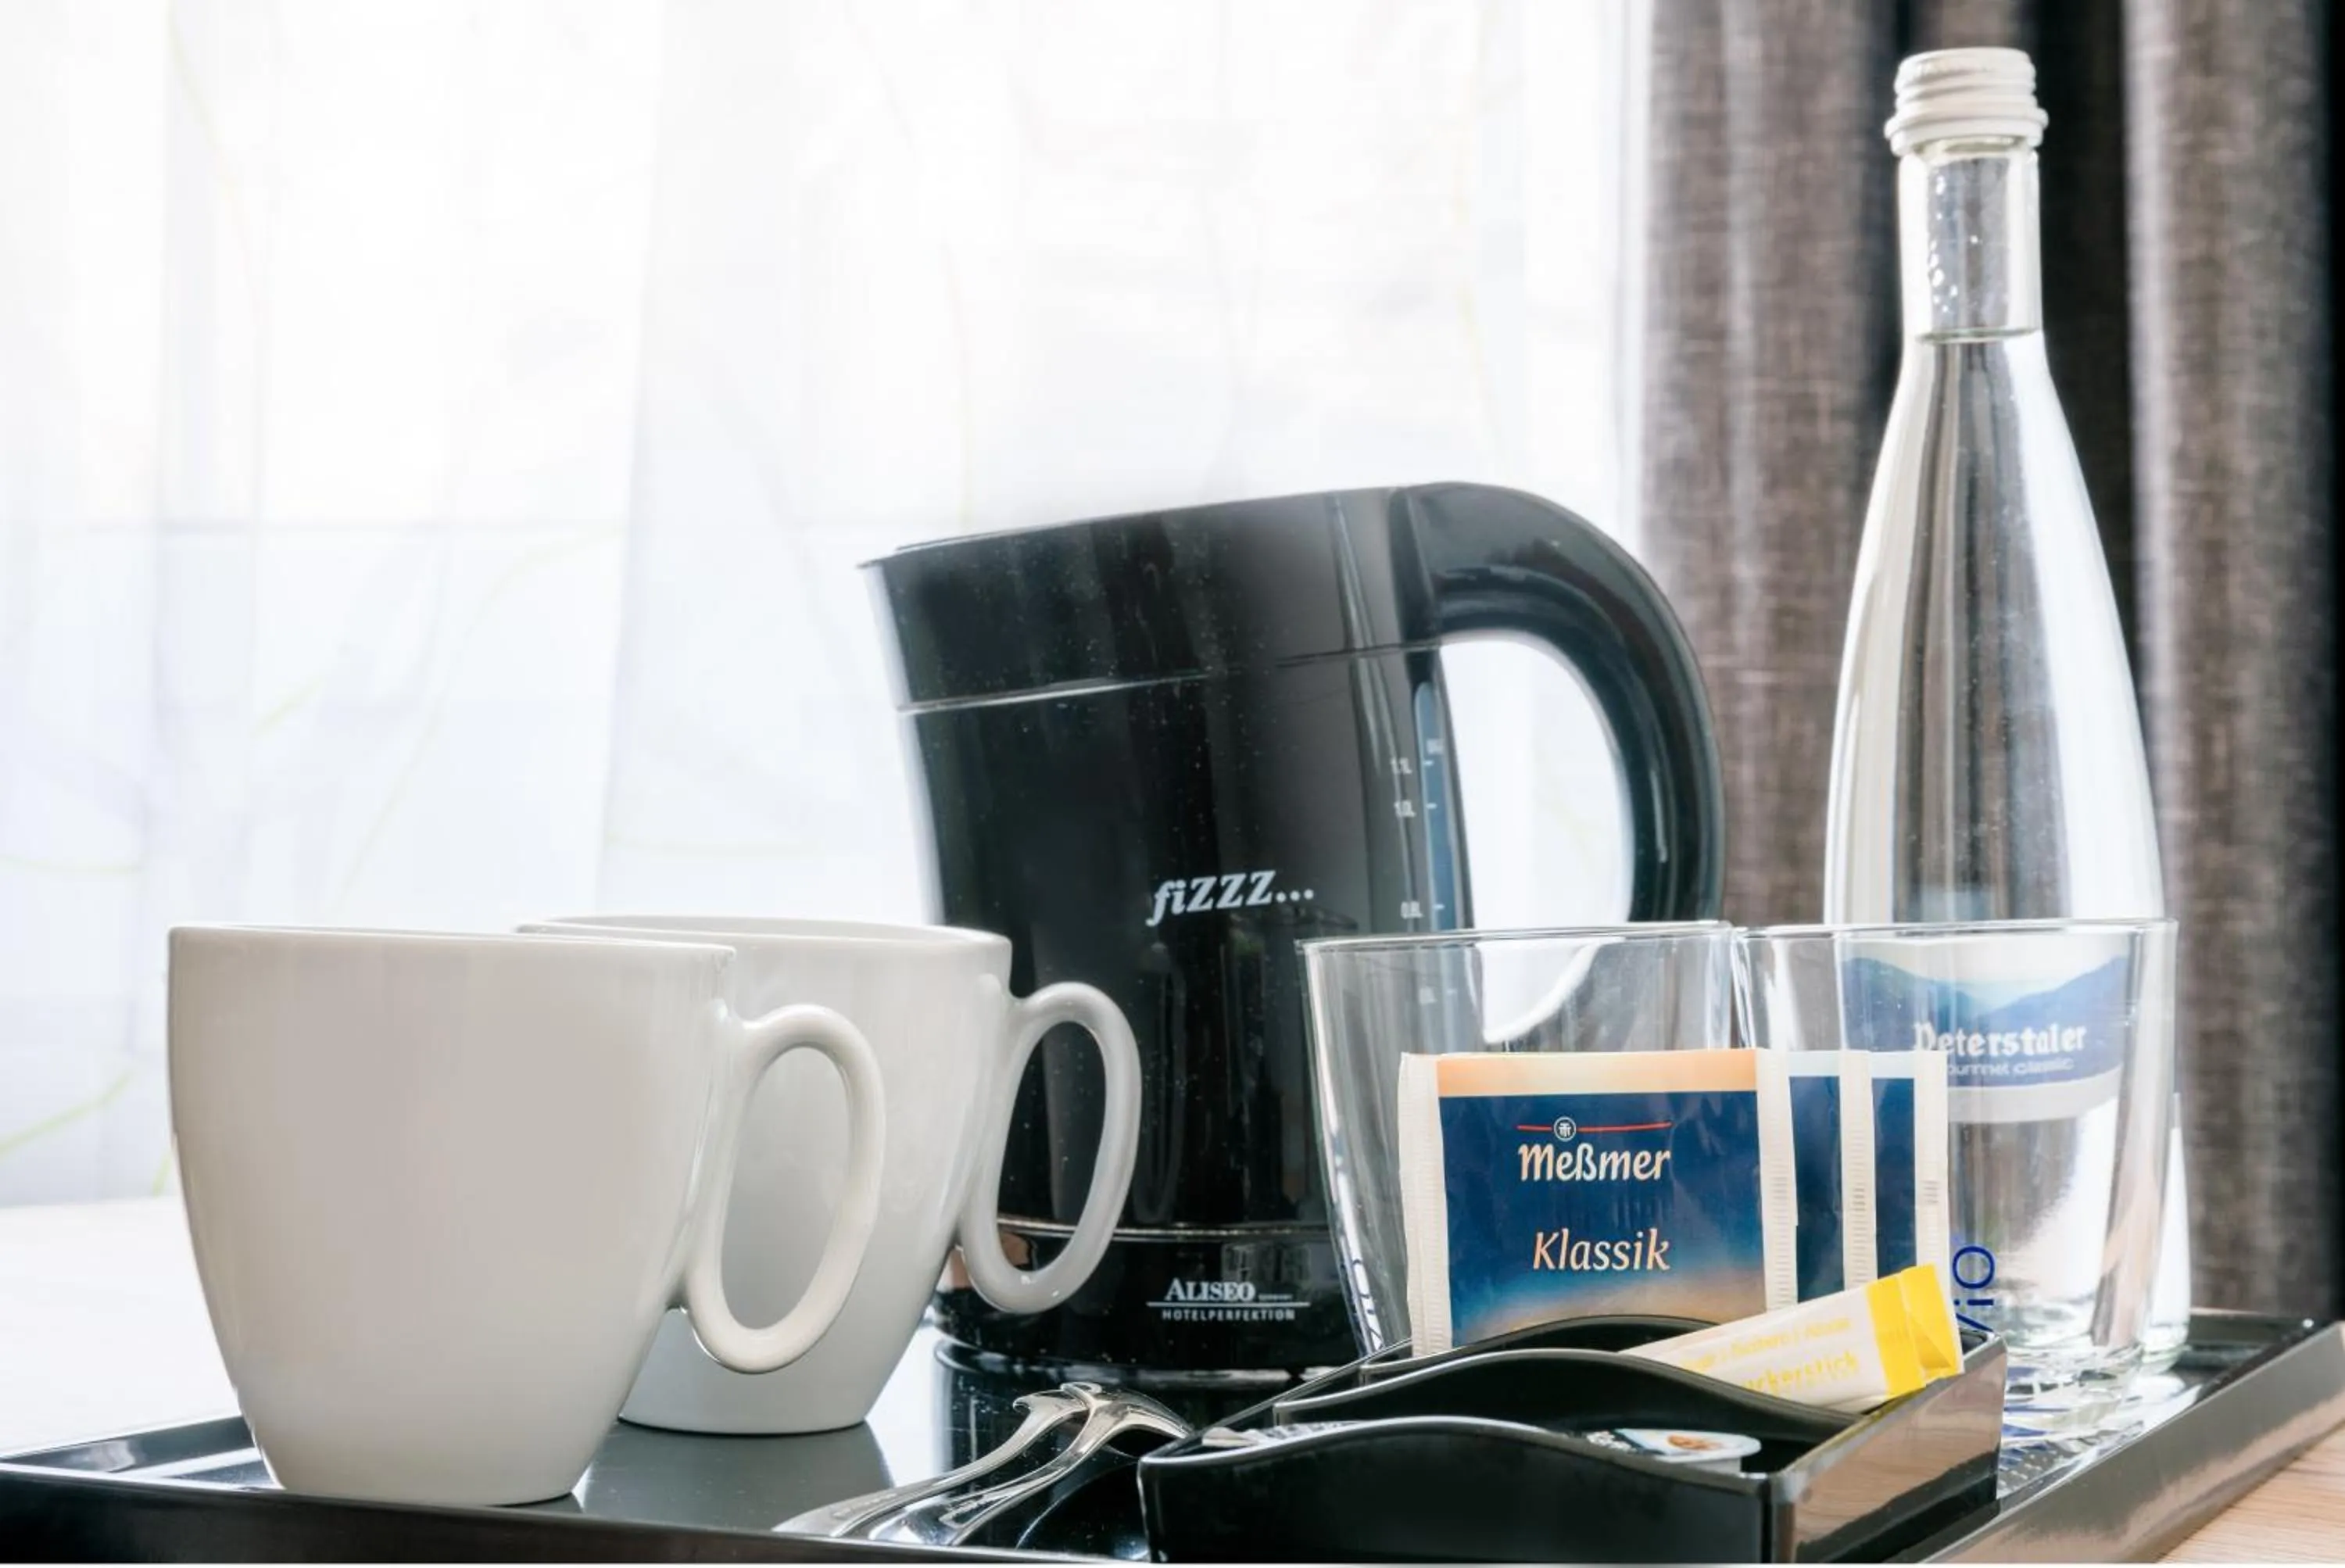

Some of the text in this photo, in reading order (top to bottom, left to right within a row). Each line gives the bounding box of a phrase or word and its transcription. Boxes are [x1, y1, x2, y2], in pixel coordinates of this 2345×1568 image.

[1518, 1142, 1672, 1182] Meßmer
[1533, 1227, 1671, 1271] Klassik
[1164, 1277, 1256, 1302] ALISEO
[1162, 1308, 1295, 1322] HOTELPERFEKTION
